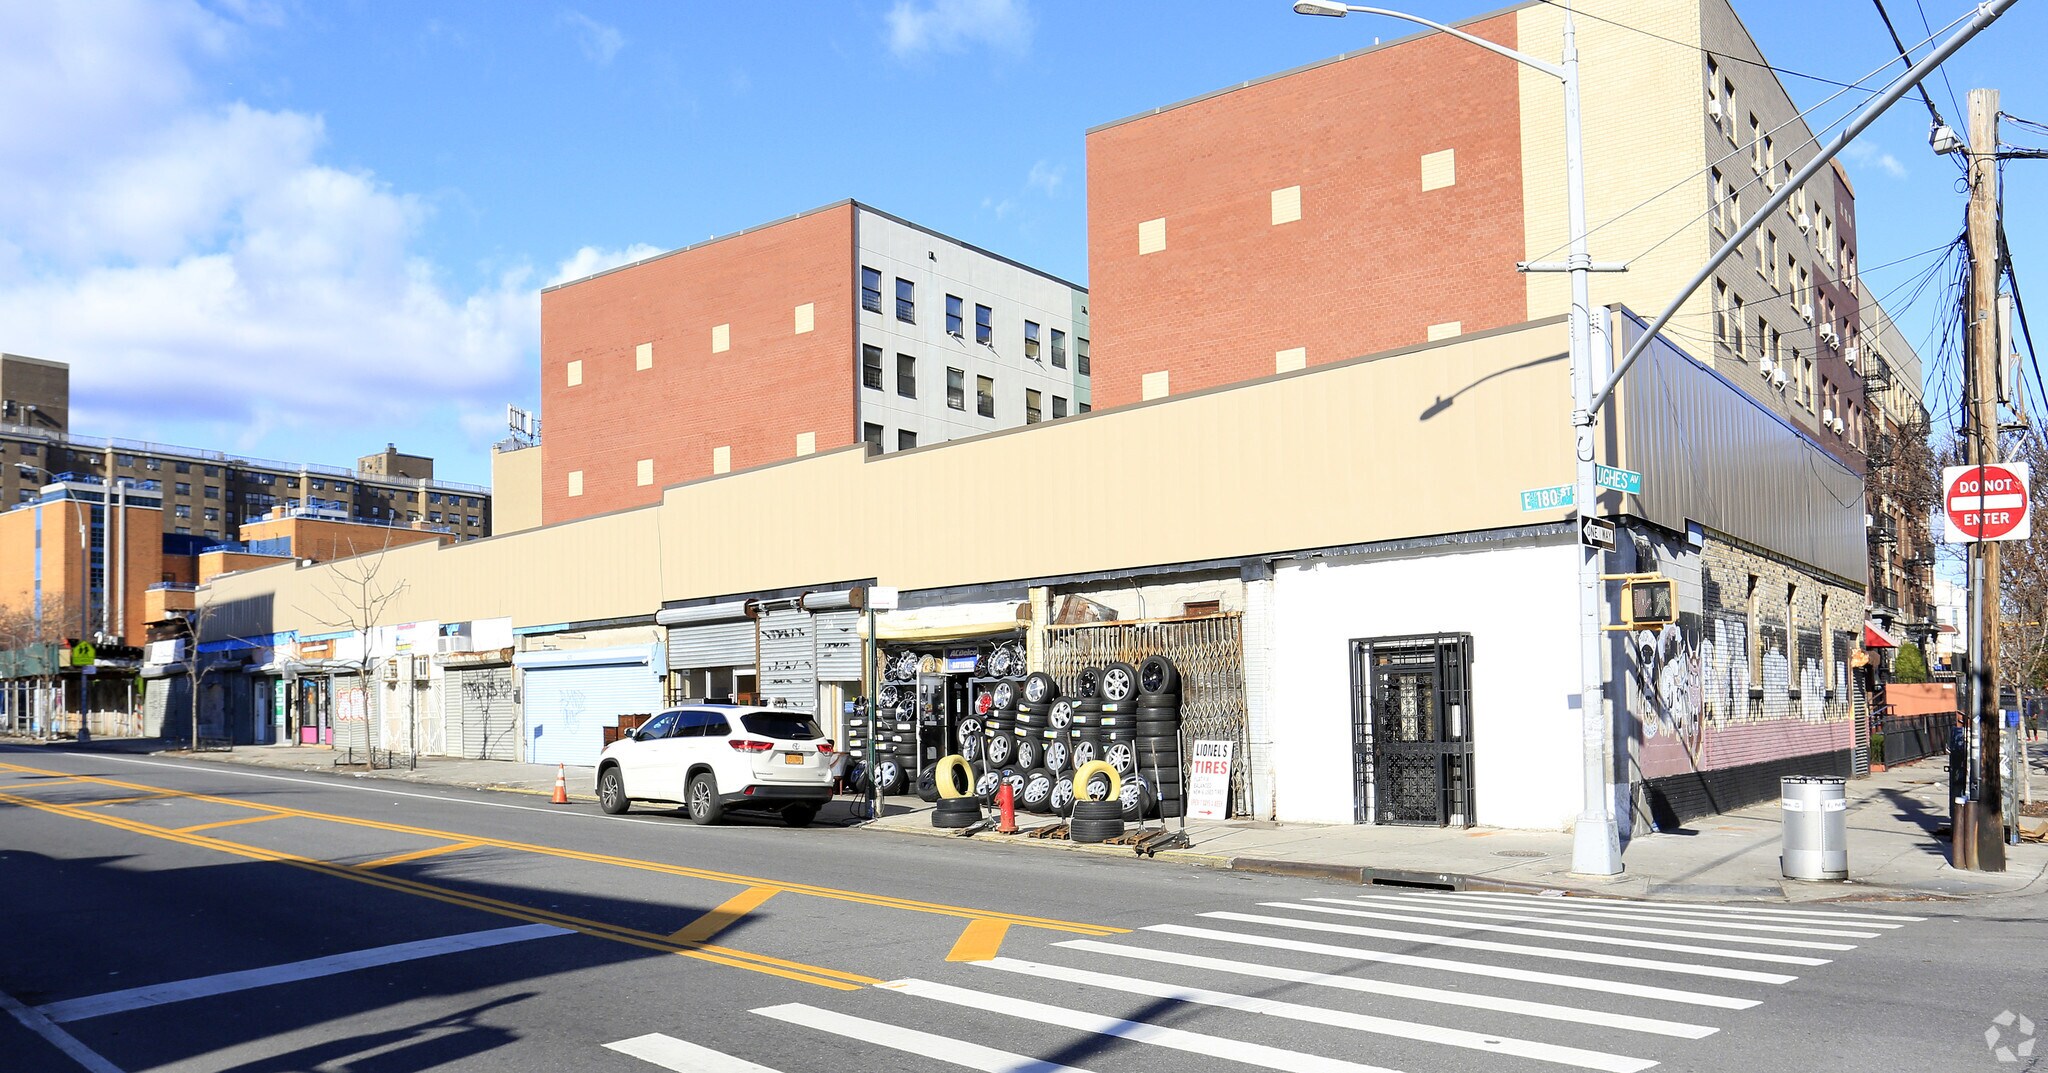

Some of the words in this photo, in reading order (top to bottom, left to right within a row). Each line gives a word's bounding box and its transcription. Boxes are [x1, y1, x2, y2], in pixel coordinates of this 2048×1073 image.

[1597, 467, 1628, 489] UGHES
[1630, 475, 1639, 484] AV
[1960, 481, 1979, 493] DO
[1984, 479, 2012, 492] NOT
[1524, 493, 1532, 509] E
[1536, 489, 1558, 508] 180
[1560, 487, 1571, 497] ST
[1964, 512, 2010, 526] ENTER
[1586, 525, 1598, 539] ONE
[1602, 529, 1612, 539] WAY
[1195, 761, 1227, 774] TIRES
